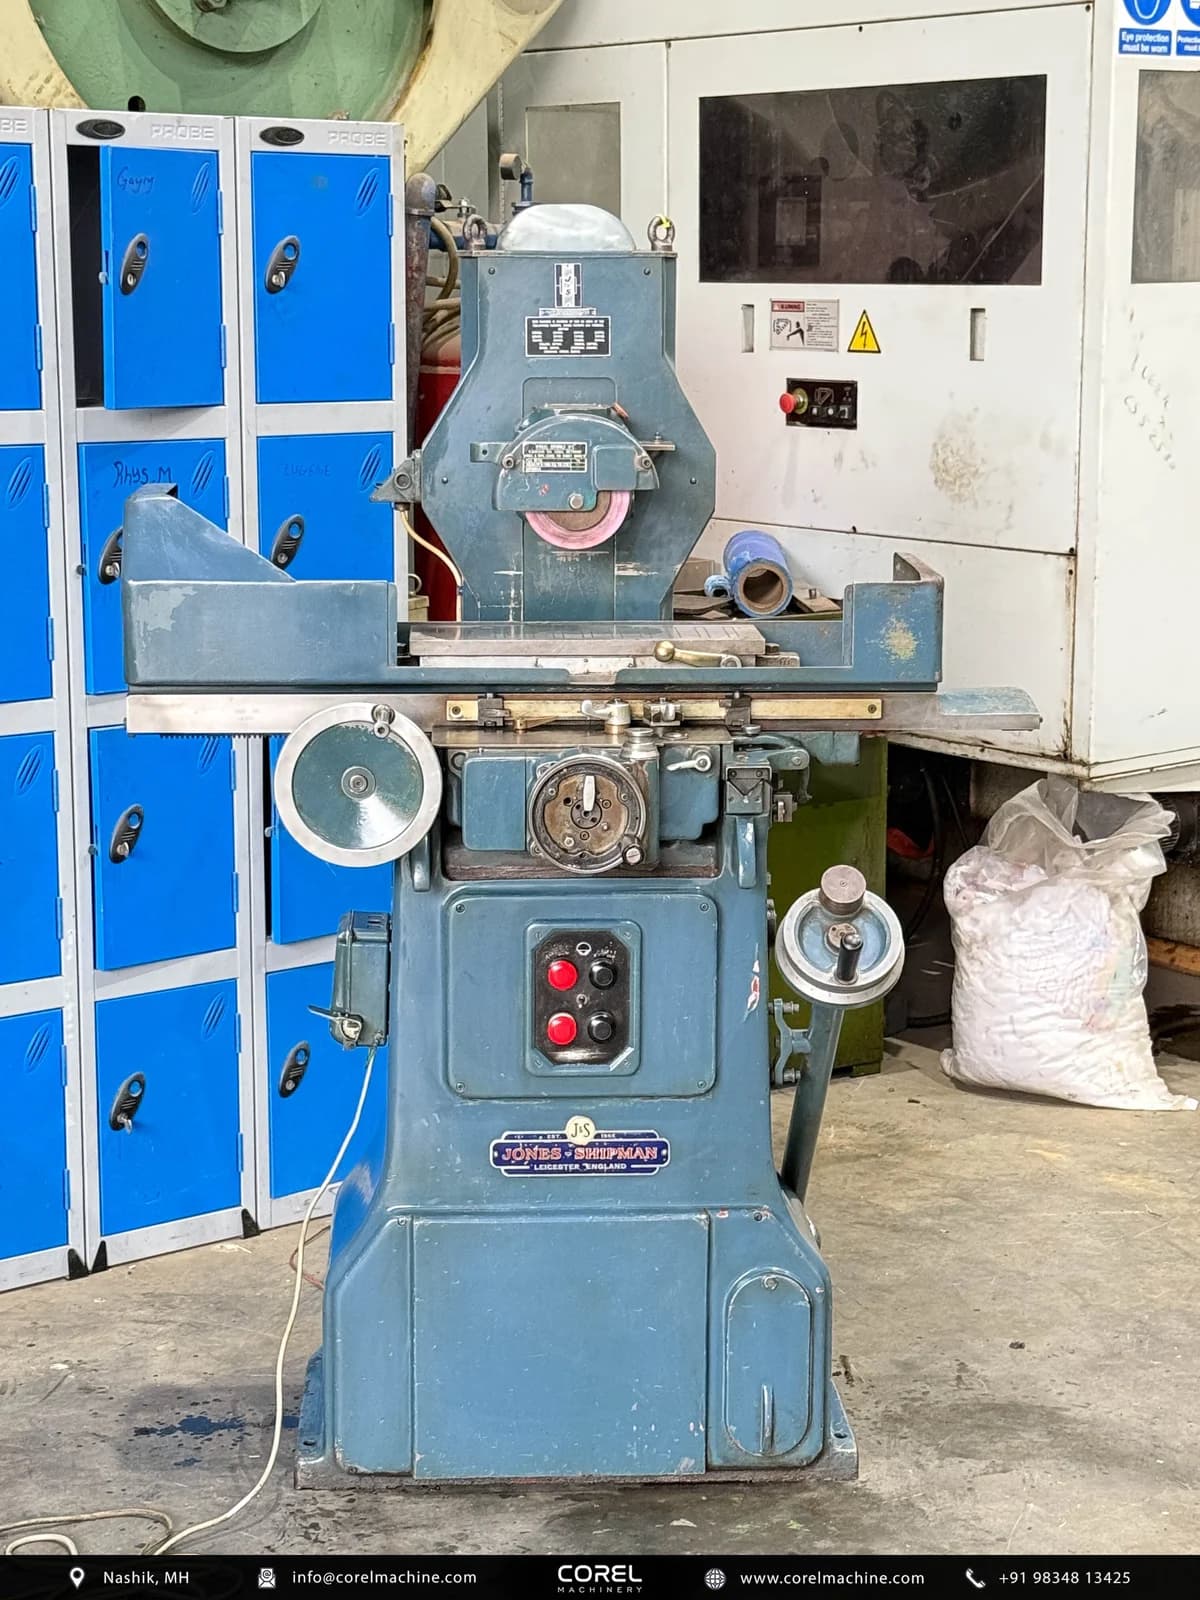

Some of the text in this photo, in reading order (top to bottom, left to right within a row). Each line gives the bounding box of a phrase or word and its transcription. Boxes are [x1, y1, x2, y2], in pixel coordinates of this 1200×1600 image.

[1121, 31, 1169, 43] Eye protection
[1141, 43, 1150, 53] be
[151, 124, 215, 140] PROBE
[328, 130, 387, 146] PROBE
[502, 1146, 658, 1161] JONES SHIPMAN
[534, 1162, 627, 1171] LEICESTER ENGLAND
